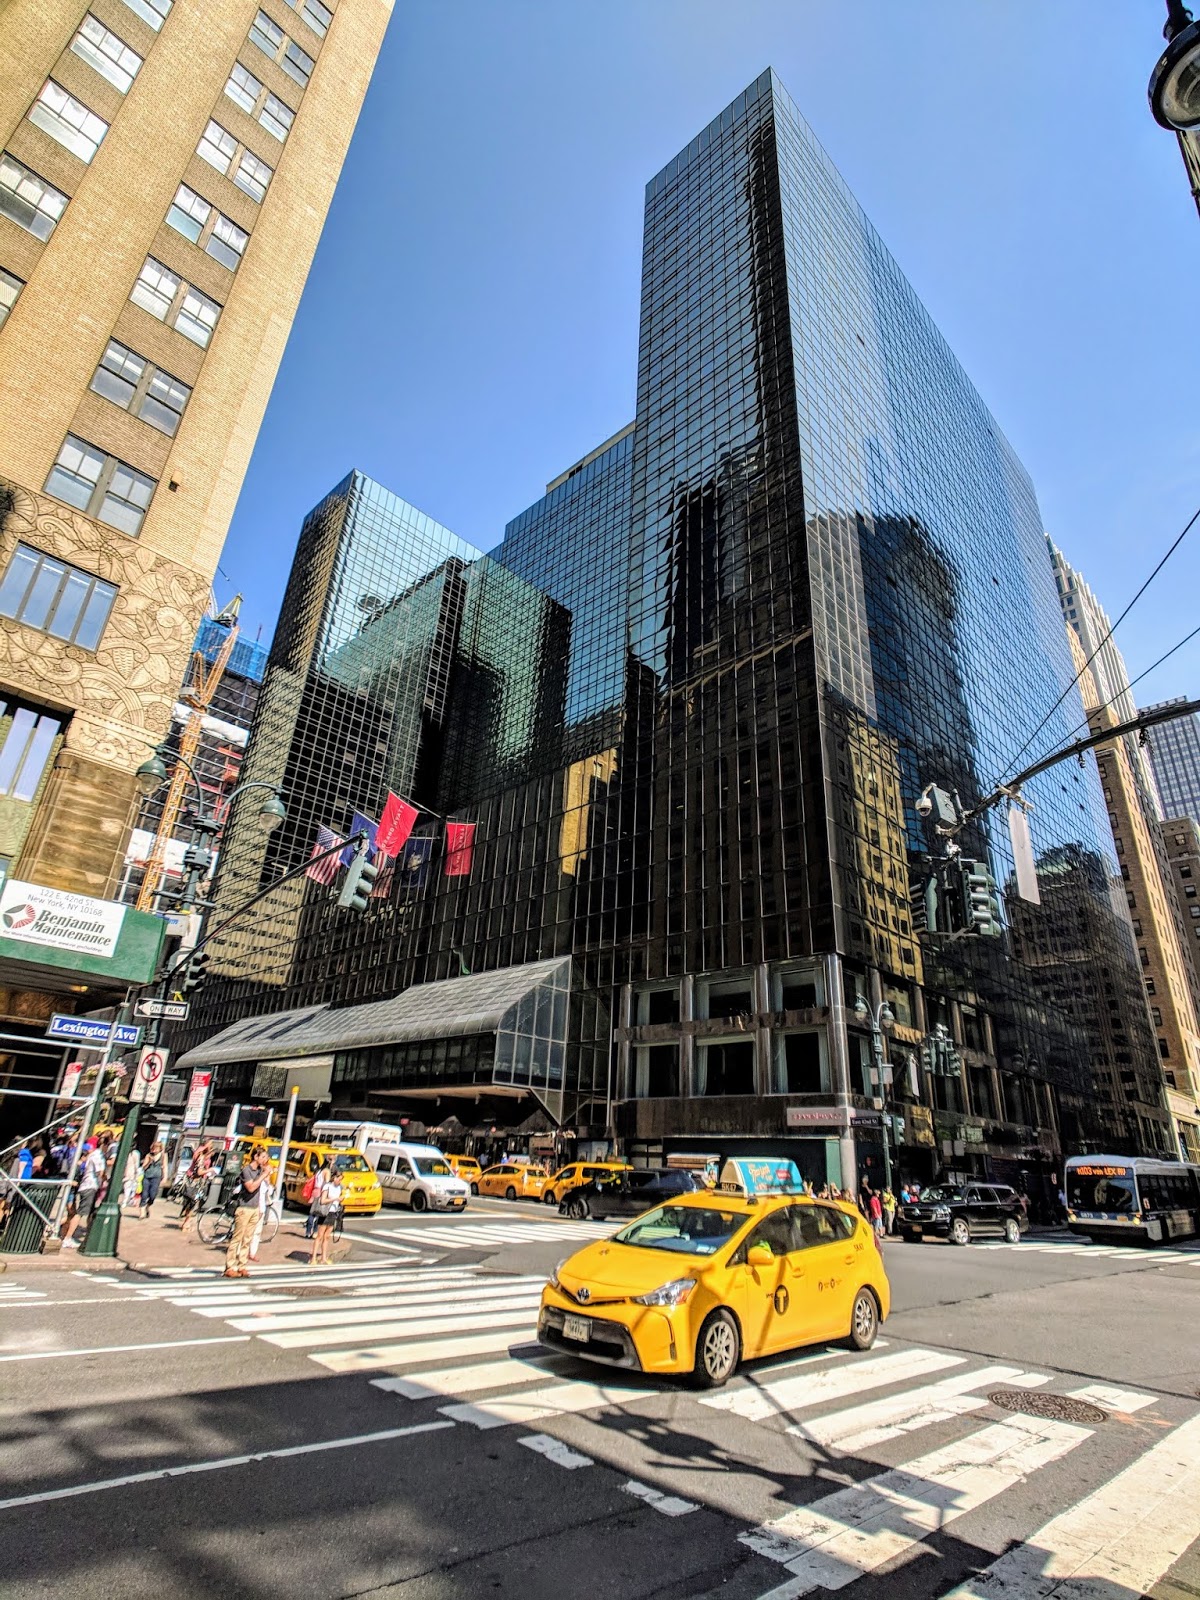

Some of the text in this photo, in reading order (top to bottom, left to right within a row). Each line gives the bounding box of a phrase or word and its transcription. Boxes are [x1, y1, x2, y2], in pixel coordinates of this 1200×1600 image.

[27, 894, 103, 917] New York, NY 10168
[40, 889, 54, 898] 122
[64, 893, 84, 905] 42nd
[37, 909, 105, 934] Benjamin
[30, 921, 111, 947] Maintenance
[114, 1027, 136, 1041] Ave
